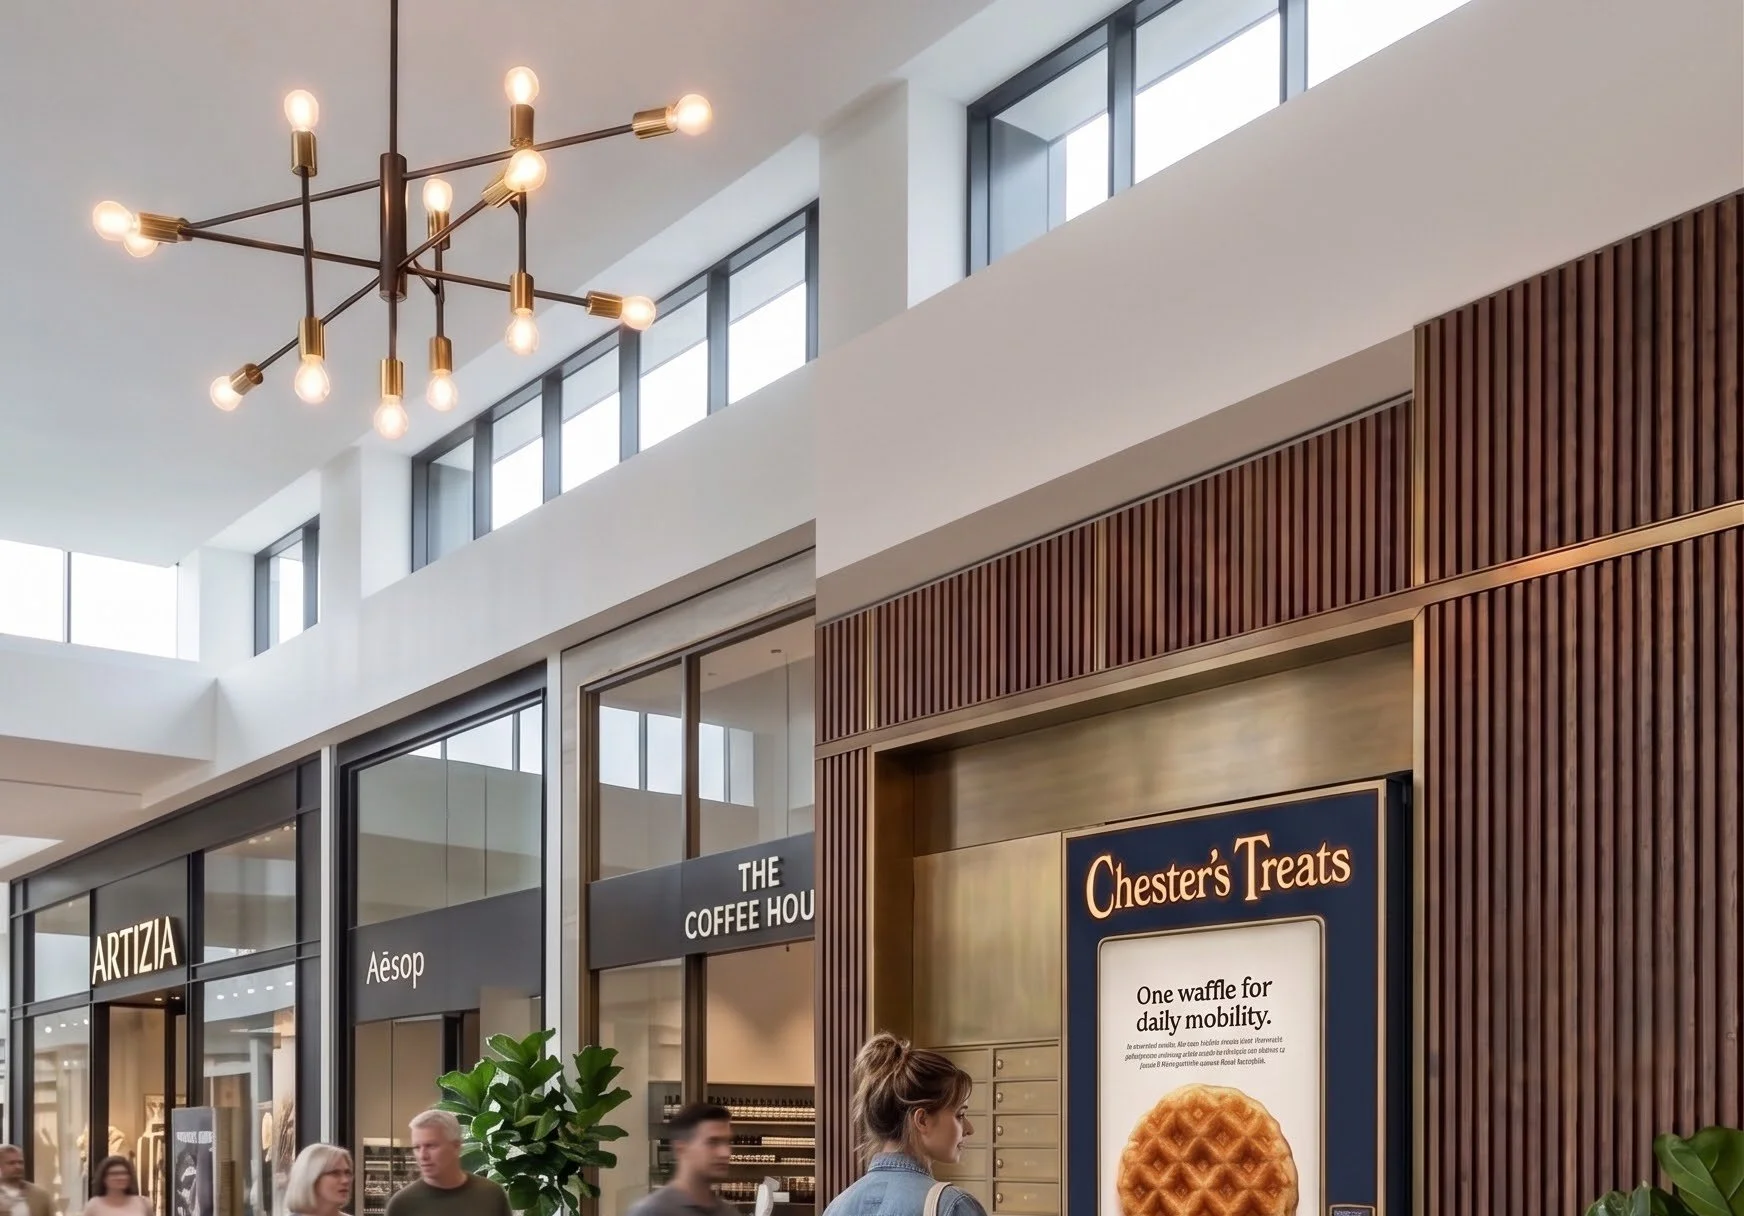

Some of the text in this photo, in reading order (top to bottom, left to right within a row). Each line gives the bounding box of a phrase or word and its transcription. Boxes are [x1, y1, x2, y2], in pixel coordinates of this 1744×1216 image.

[738, 856, 780, 892] THE
[1086, 833, 1351, 919] Chester's Treats
[685, 899, 760, 939] COFFEE
[92, 915, 177, 985] ARTIZIA
[1136, 976, 1273, 1005] One waffle for
[1136, 1004, 1272, 1036] daily mobility.
